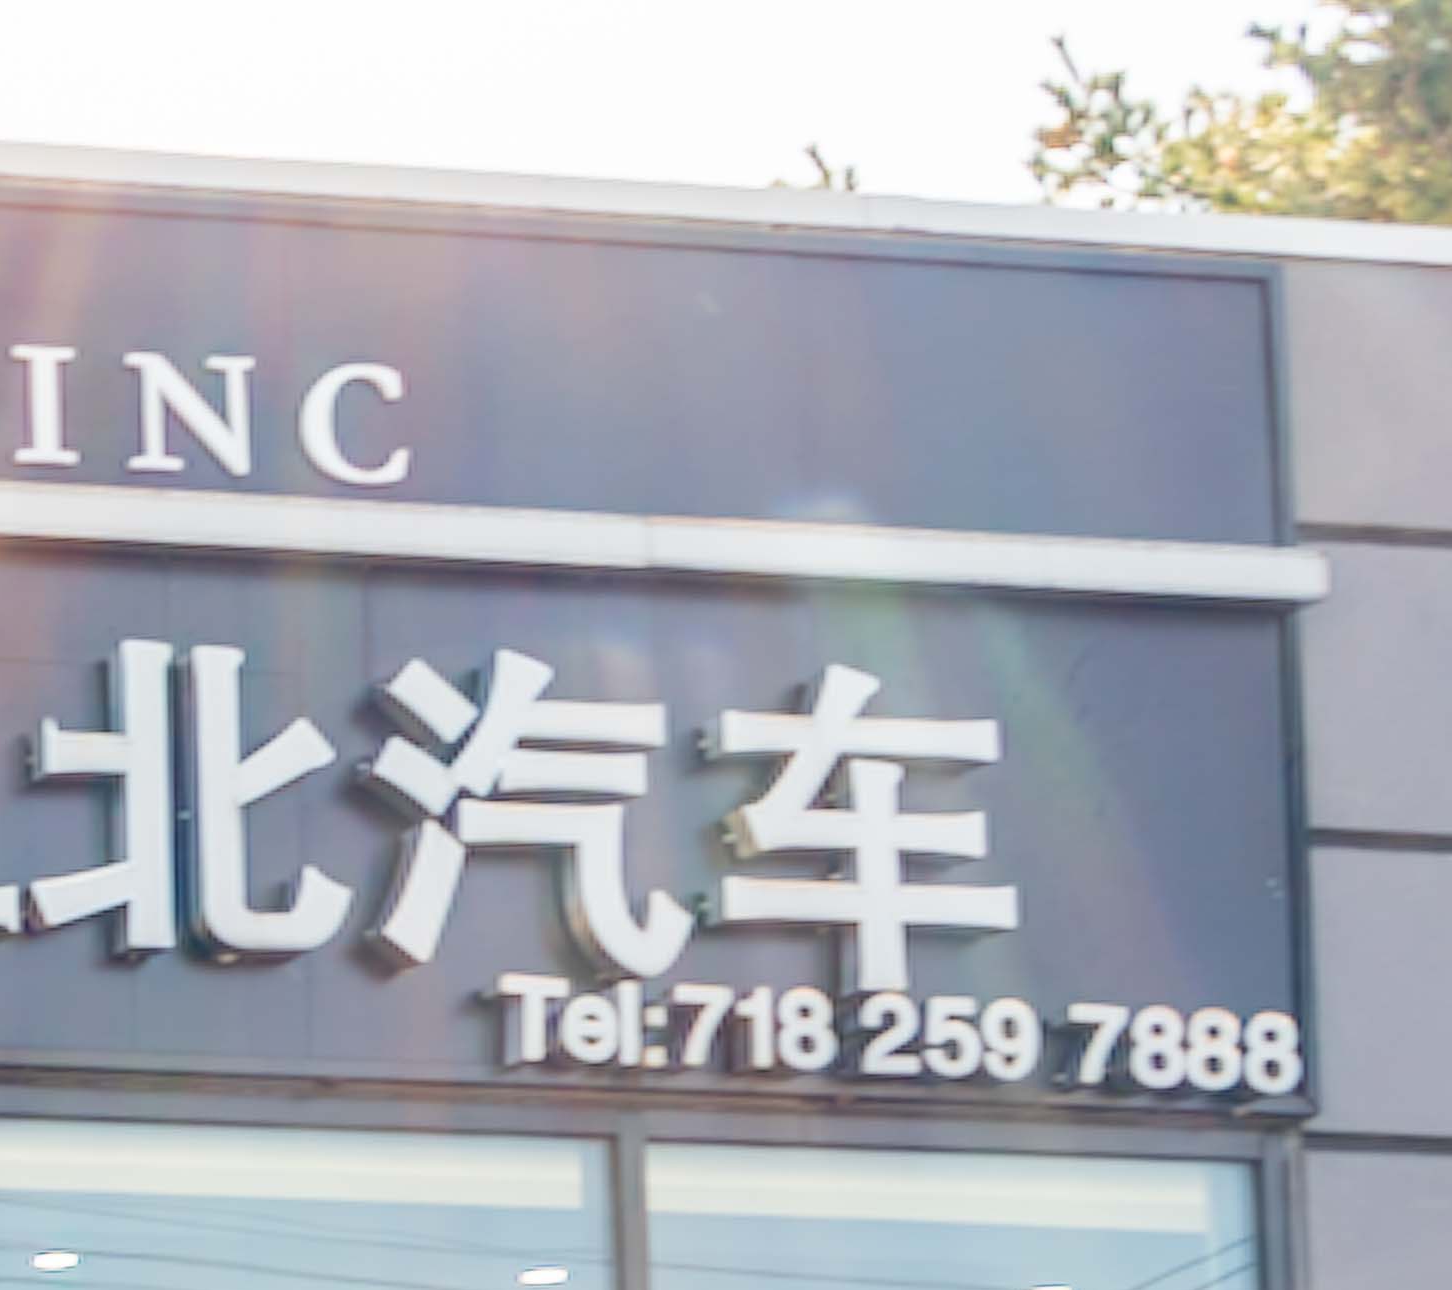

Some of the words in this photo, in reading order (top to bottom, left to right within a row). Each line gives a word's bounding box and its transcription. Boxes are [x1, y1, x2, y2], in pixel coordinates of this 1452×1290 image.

[8, 342, 414, 486] INC
[859, 992, 1038, 1082] 259
[1063, 1002, 1304, 1096] 7888
